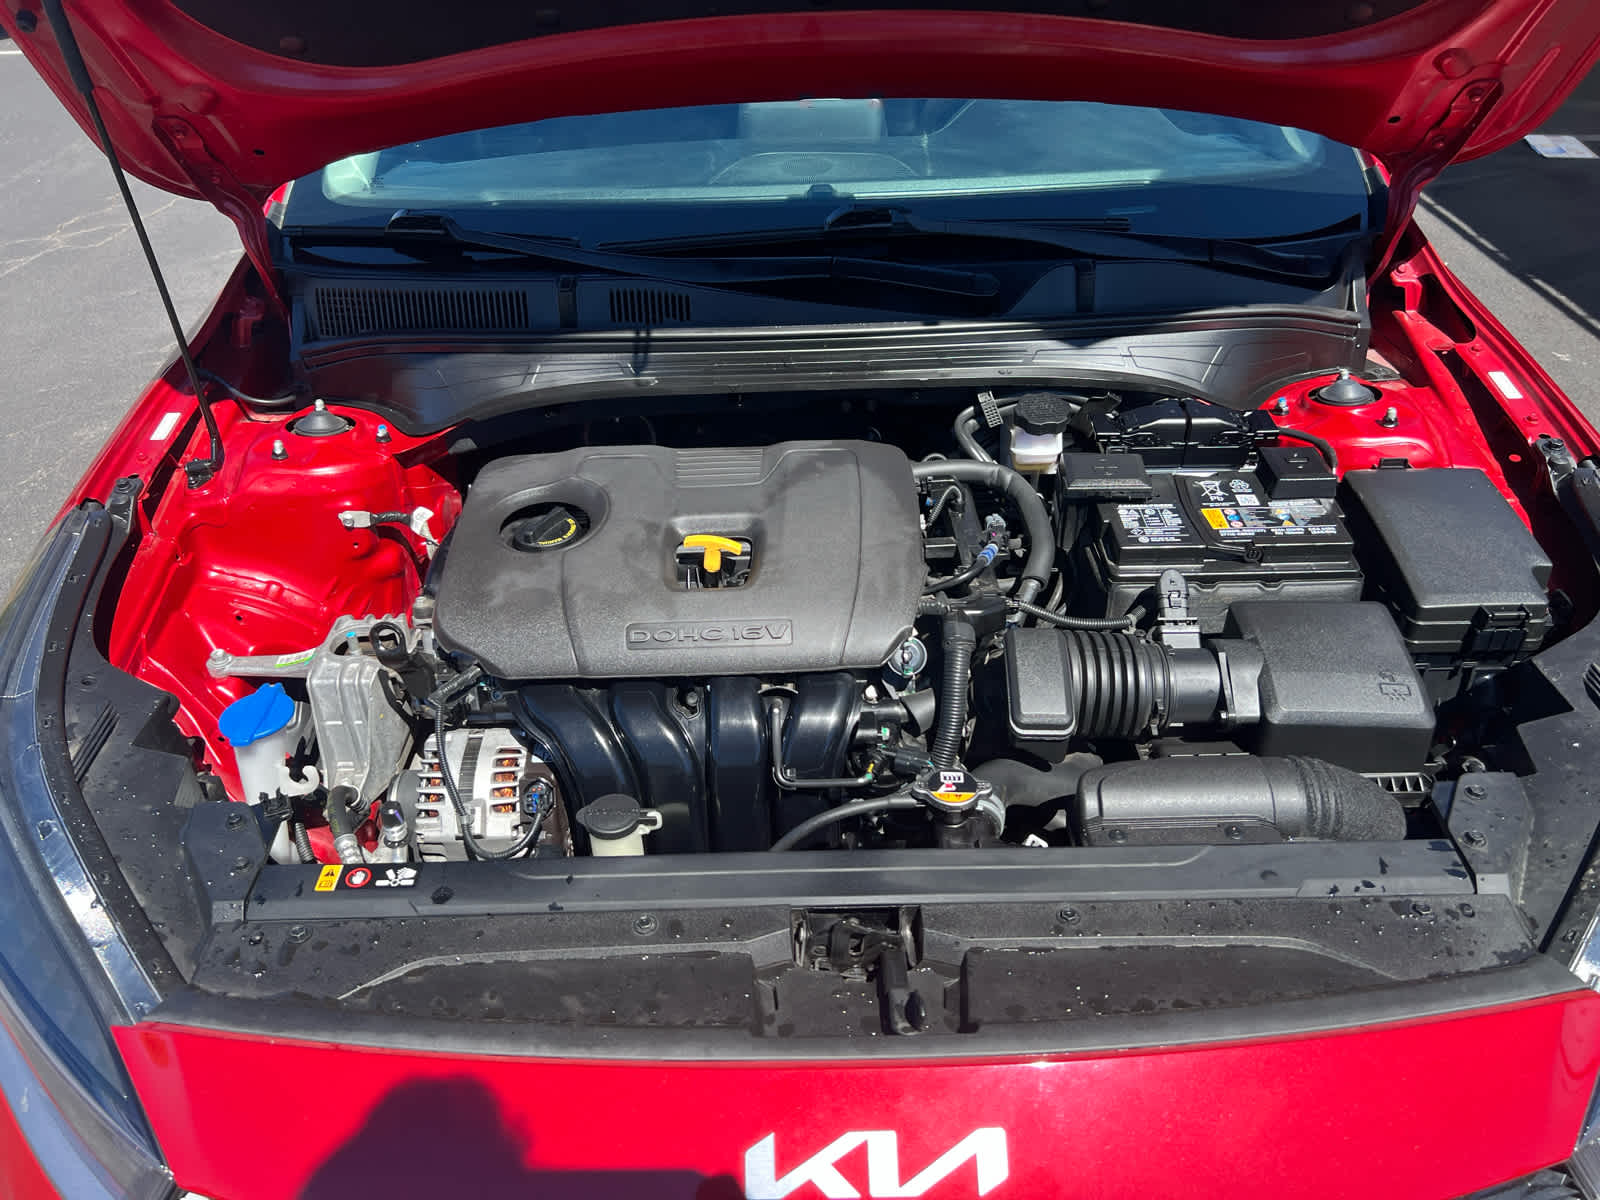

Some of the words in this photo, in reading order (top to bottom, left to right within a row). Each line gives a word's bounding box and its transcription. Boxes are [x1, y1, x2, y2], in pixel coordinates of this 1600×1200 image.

[629, 626, 724, 644] DOHC
[731, 624, 789, 641] 16V
[744, 1126, 1009, 1200] KIA
